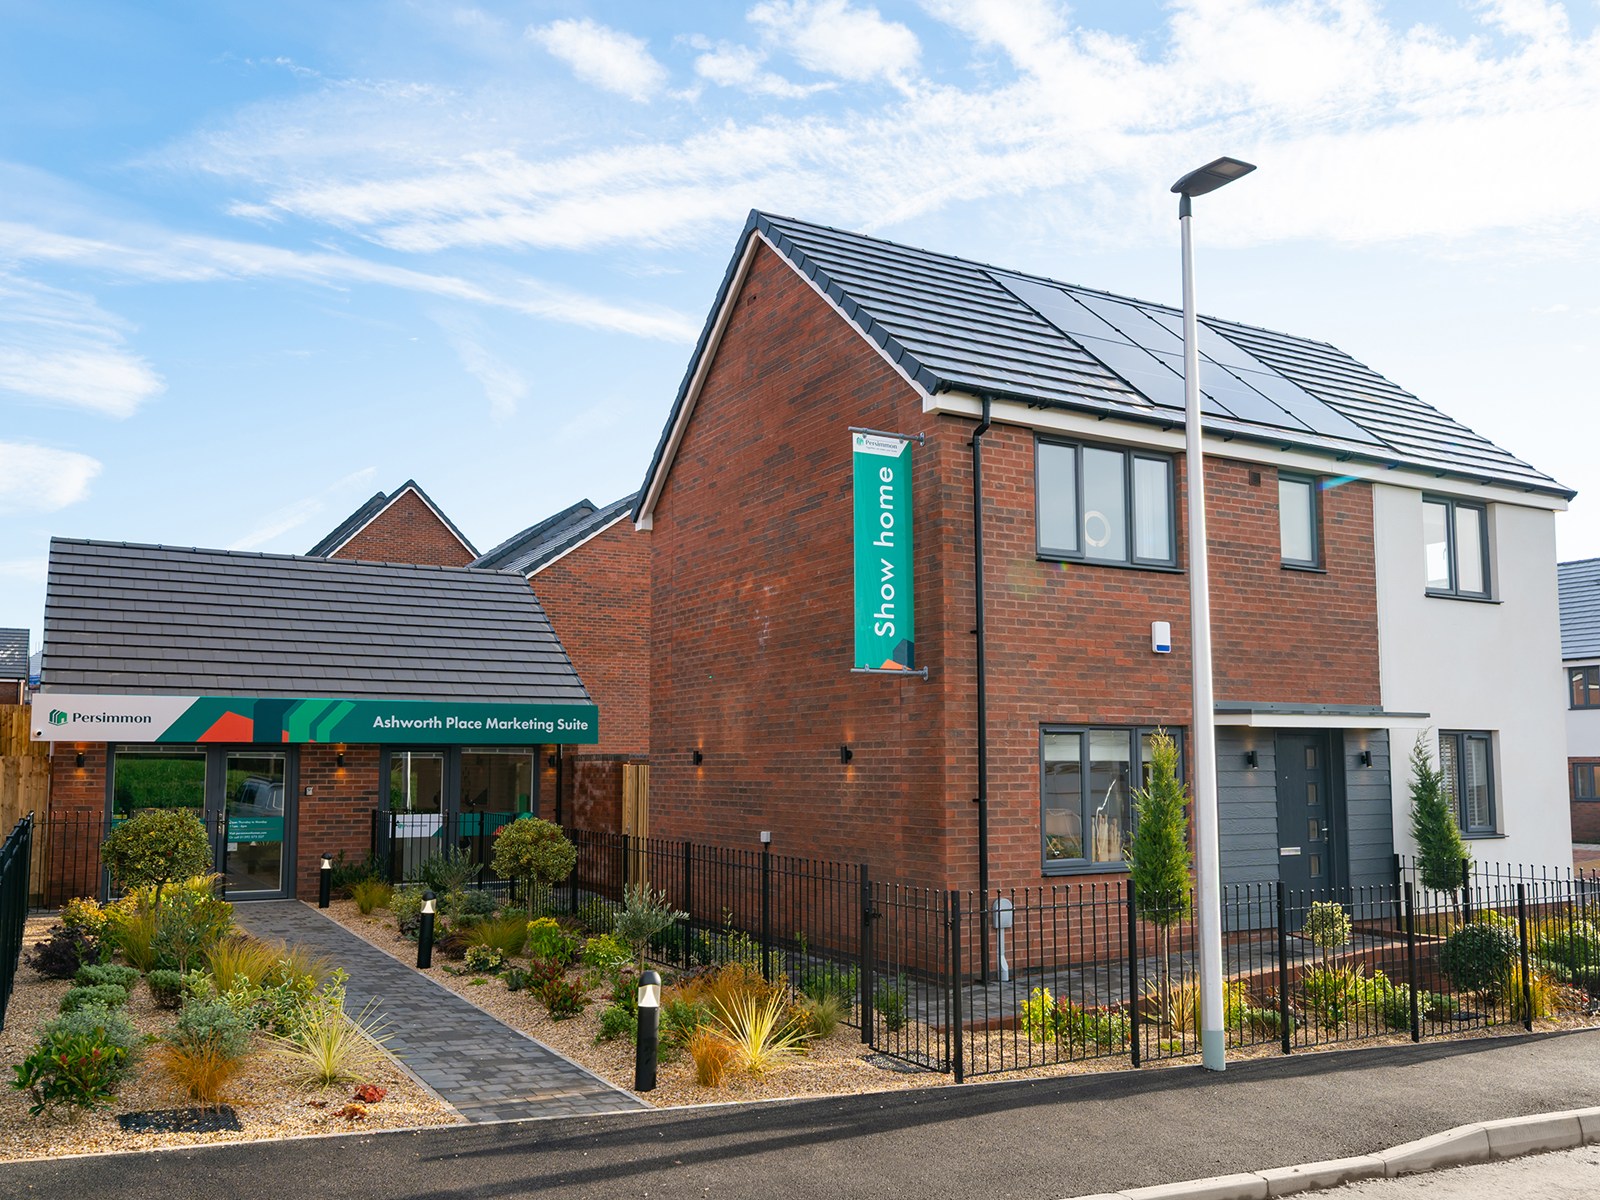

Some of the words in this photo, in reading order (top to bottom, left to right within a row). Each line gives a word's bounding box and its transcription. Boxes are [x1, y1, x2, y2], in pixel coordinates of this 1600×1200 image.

[865, 439, 898, 449] Persimmon
[873, 467, 895, 547] home
[874, 559, 896, 637] Show
[72, 711, 152, 724] Persimmon
[372, 715, 442, 729] Ashworth
[446, 716, 483, 729] Place
[485, 717, 554, 733] Marketing
[557, 718, 589, 731] Suite
